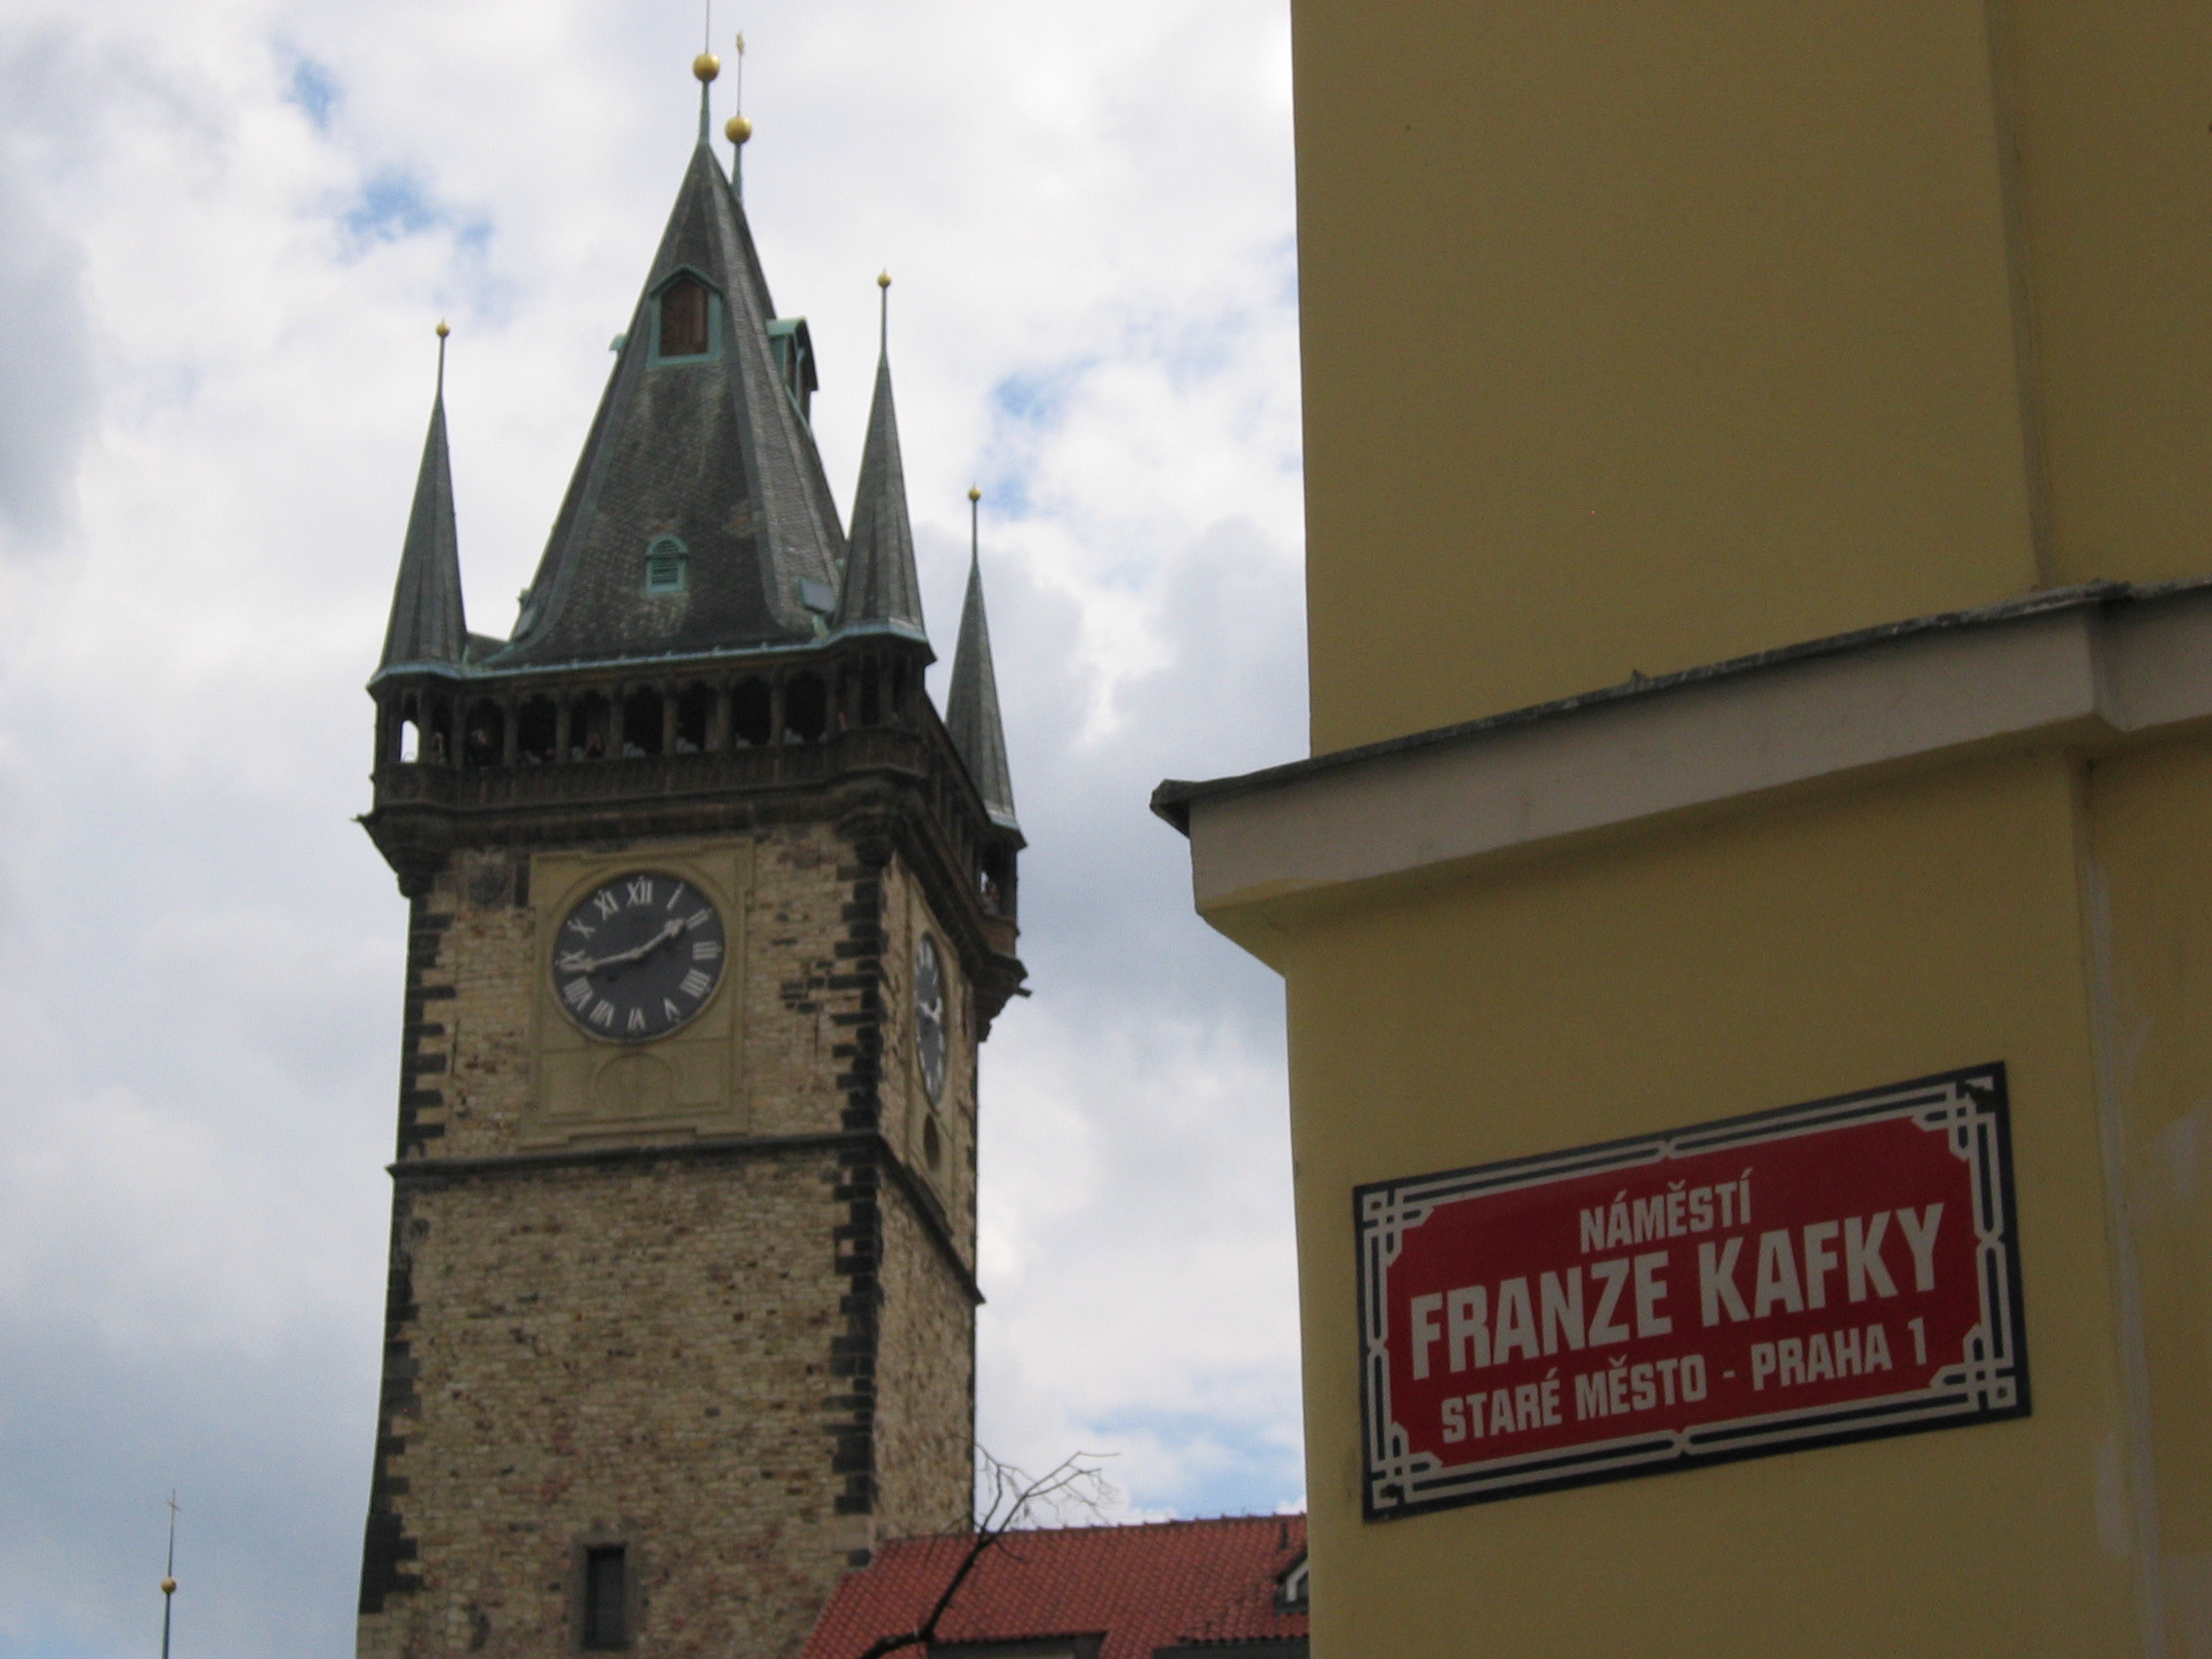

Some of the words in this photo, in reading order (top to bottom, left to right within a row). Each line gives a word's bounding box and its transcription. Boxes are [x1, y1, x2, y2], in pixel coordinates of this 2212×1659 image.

[593, 889, 619, 921] XI
[626, 879, 653, 907] XII
[1580, 1167, 1752, 1253] NÁMĚSTÍ
[1410, 1251, 1673, 1380] FRANZE
[1698, 1202, 1945, 1328] KAFKY
[1441, 1368, 1563, 1444] STARÉ
[1574, 1355, 1708, 1420] MĚSTO
[1751, 1323, 1893, 1391] PRAHA
[1907, 1316, 1927, 1367] 1
